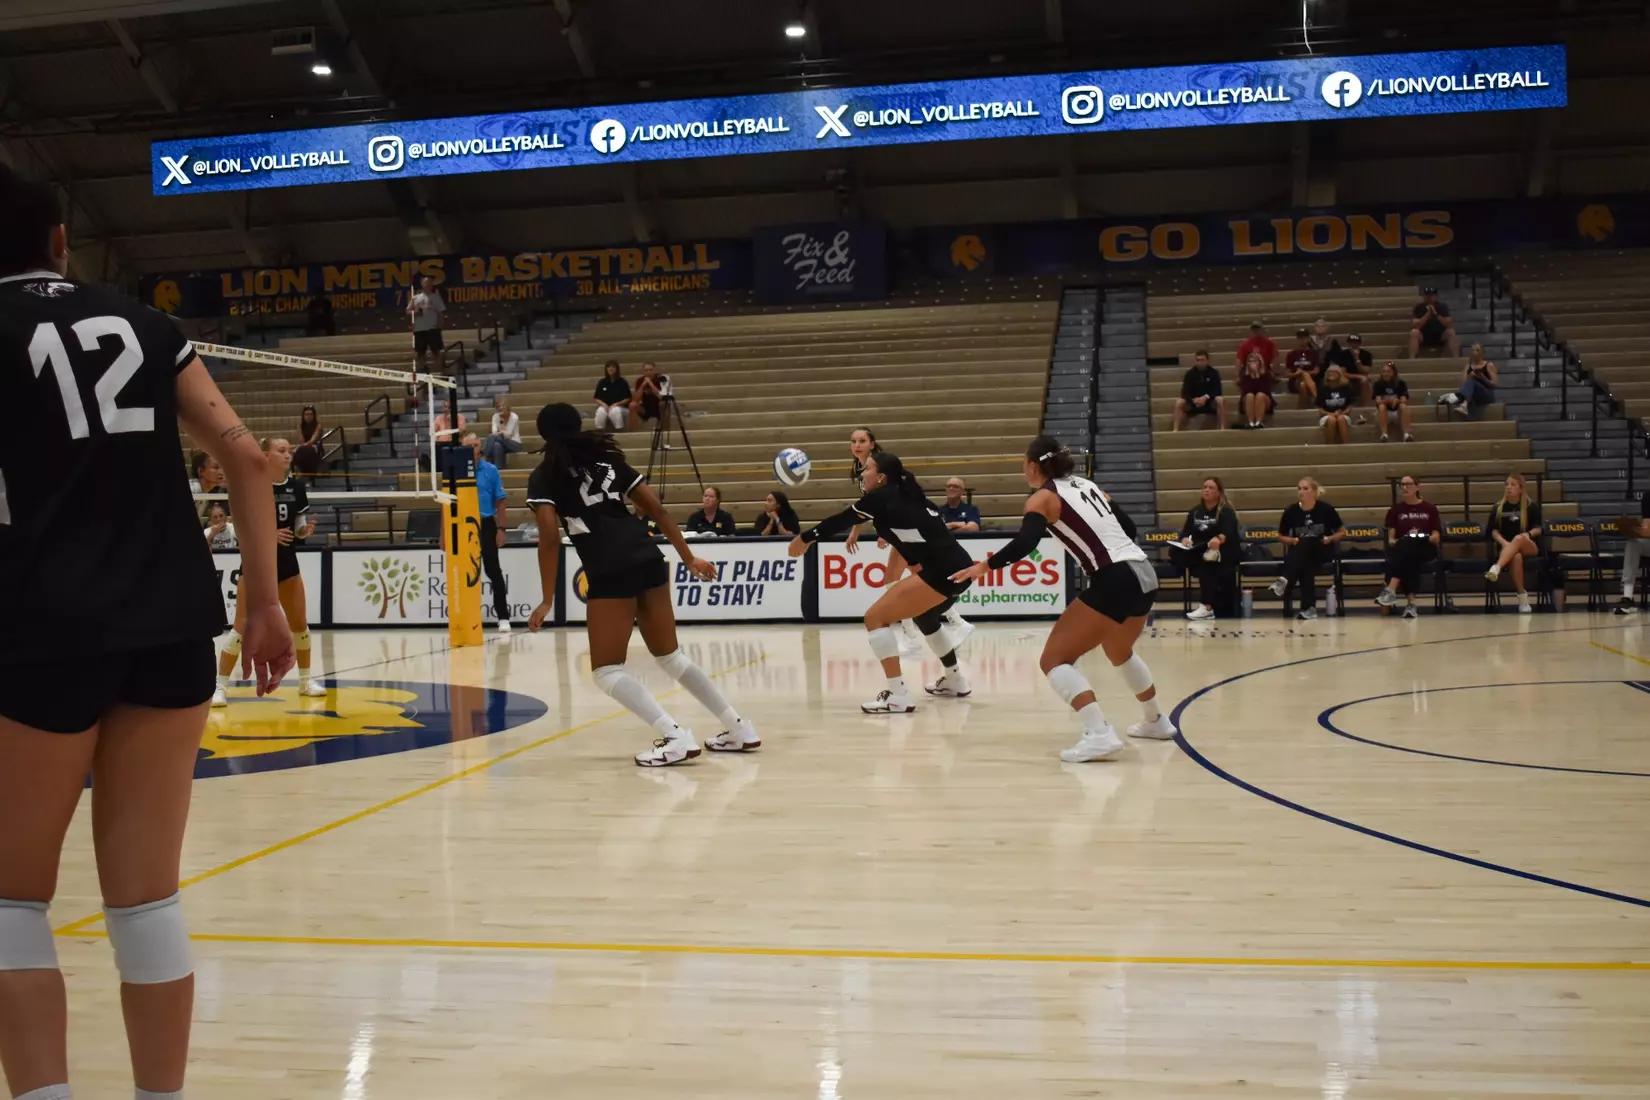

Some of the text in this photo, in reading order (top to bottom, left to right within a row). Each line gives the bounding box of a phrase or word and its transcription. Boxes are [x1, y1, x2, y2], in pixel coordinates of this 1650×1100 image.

[1368, 71, 1548, 95] /LIONVOLLEYBALL
[1109, 86, 1290, 110] @LIONVOLLEYBALL
[854, 101, 1039, 126] @LION_VOLLEYBALL
[631, 117, 789, 141] /LIONVOLLEYBALL
[409, 134, 563, 158] @LIONVOLLEYBALL
[194, 150, 349, 175] @LION_VOLLEYBALL
[1099, 210, 1455, 262] GO LIONS
[781, 230, 850, 267] Fix &
[221, 267, 308, 298] LION
[460, 244, 719, 283] BASKETBALL
[793, 258, 856, 290] Feed
[597, 273, 709, 296] ALL-AMERICANS
[27, 315, 155, 440] 12
[277, 503, 288, 522] 9
[1080, 488, 1112, 517] 11
[1145, 533, 1178, 542] LIONS
[1344, 529, 1378, 538] LIONS
[1445, 525, 1480, 535] LIONS
[1548, 523, 1584, 532] LIONS
[731, 559, 797, 582] PLACE
[676, 582, 763, 606] TO STAY!
[981, 589, 1059, 607] pharmacy
